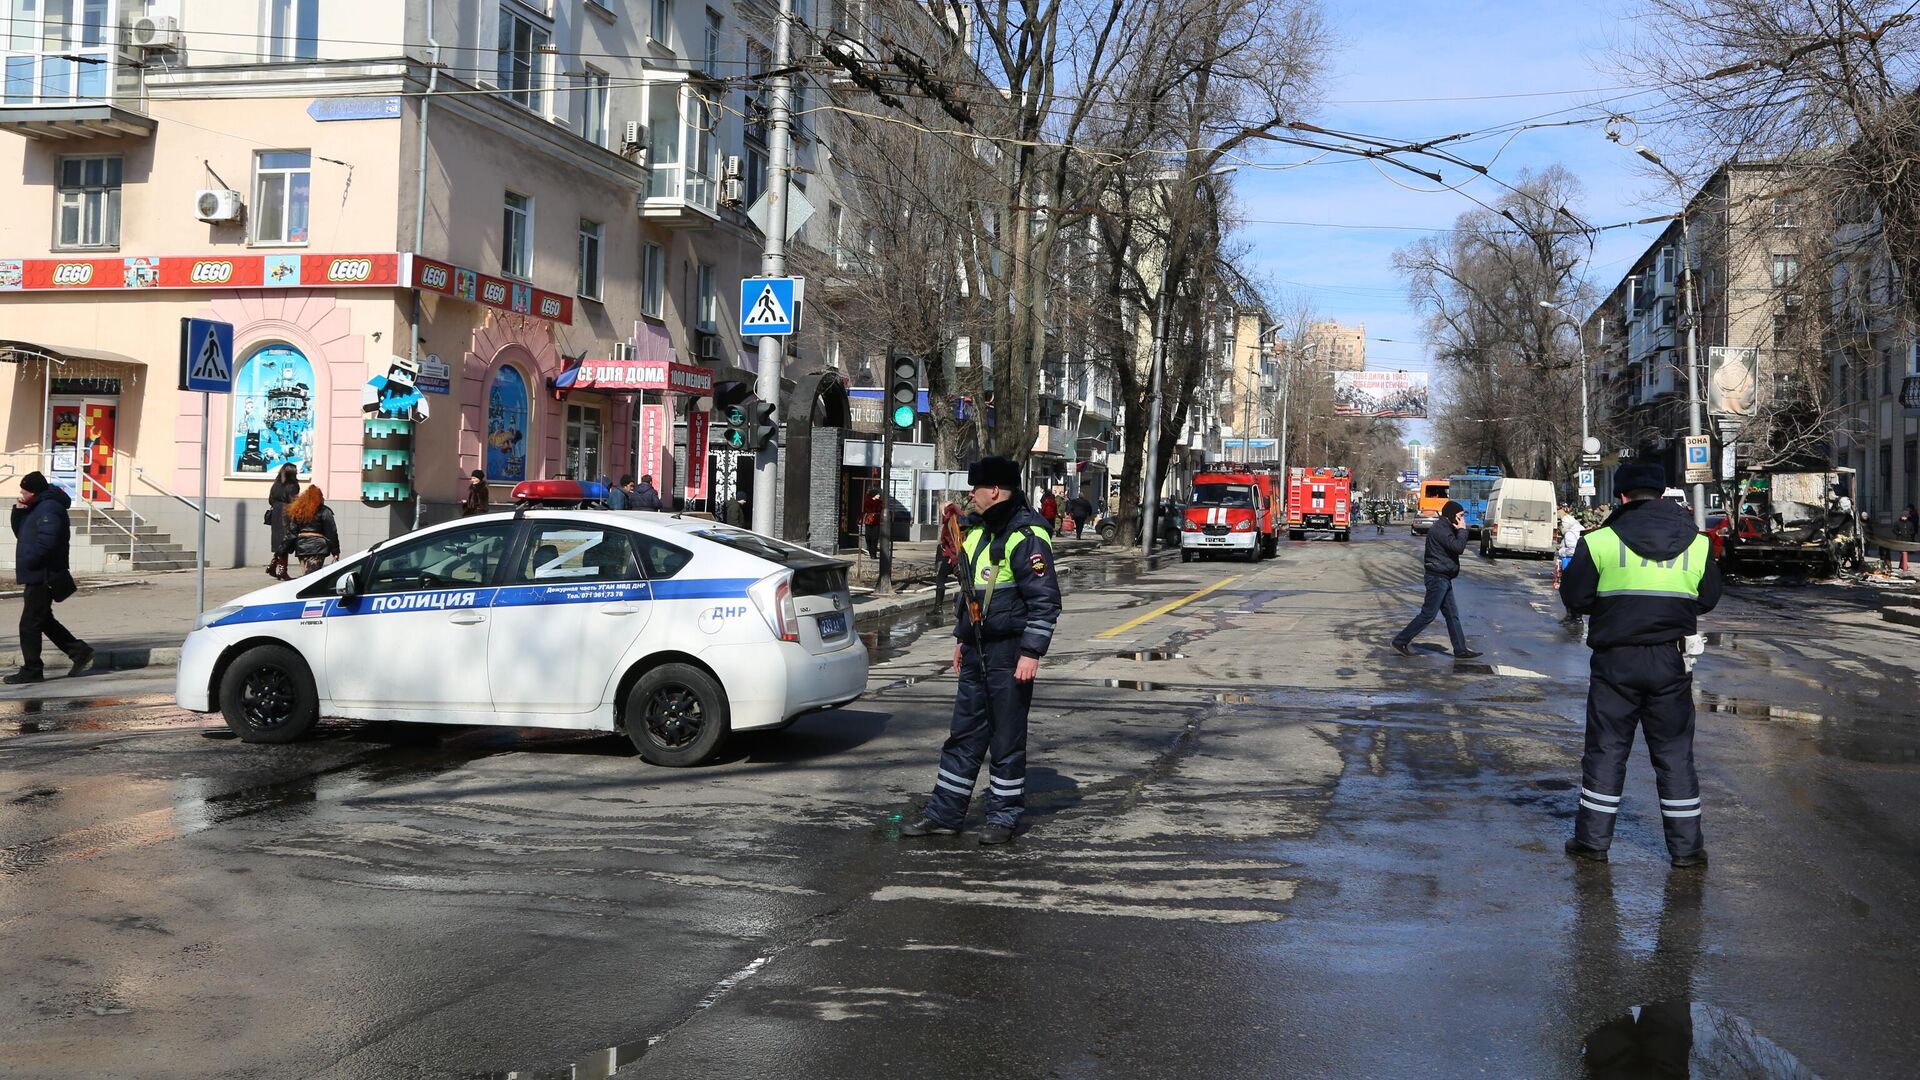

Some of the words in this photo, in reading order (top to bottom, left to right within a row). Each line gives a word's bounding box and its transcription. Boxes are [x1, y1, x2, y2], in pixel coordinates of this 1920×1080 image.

[54, 264, 92, 284] LEGO
[192, 262, 232, 282] LEGO
[329, 260, 370, 280] LEGO
[422, 266, 447, 288] LEGO
[484, 281, 505, 302] LEGO
[541, 297, 560, 317] LEGO
[577, 366, 593, 381] СЕ
[595, 366, 623, 383] ДЛЯ
[625, 366, 665, 383] ДОМА
[671, 370, 686, 386] 1000
[686, 371, 711, 390] МЕЛОЧЕЙ
[535, 531, 604, 578] Z
[371, 592, 476, 610] ПОЛИЦИЯ
[712, 606, 747, 620] ДНР
